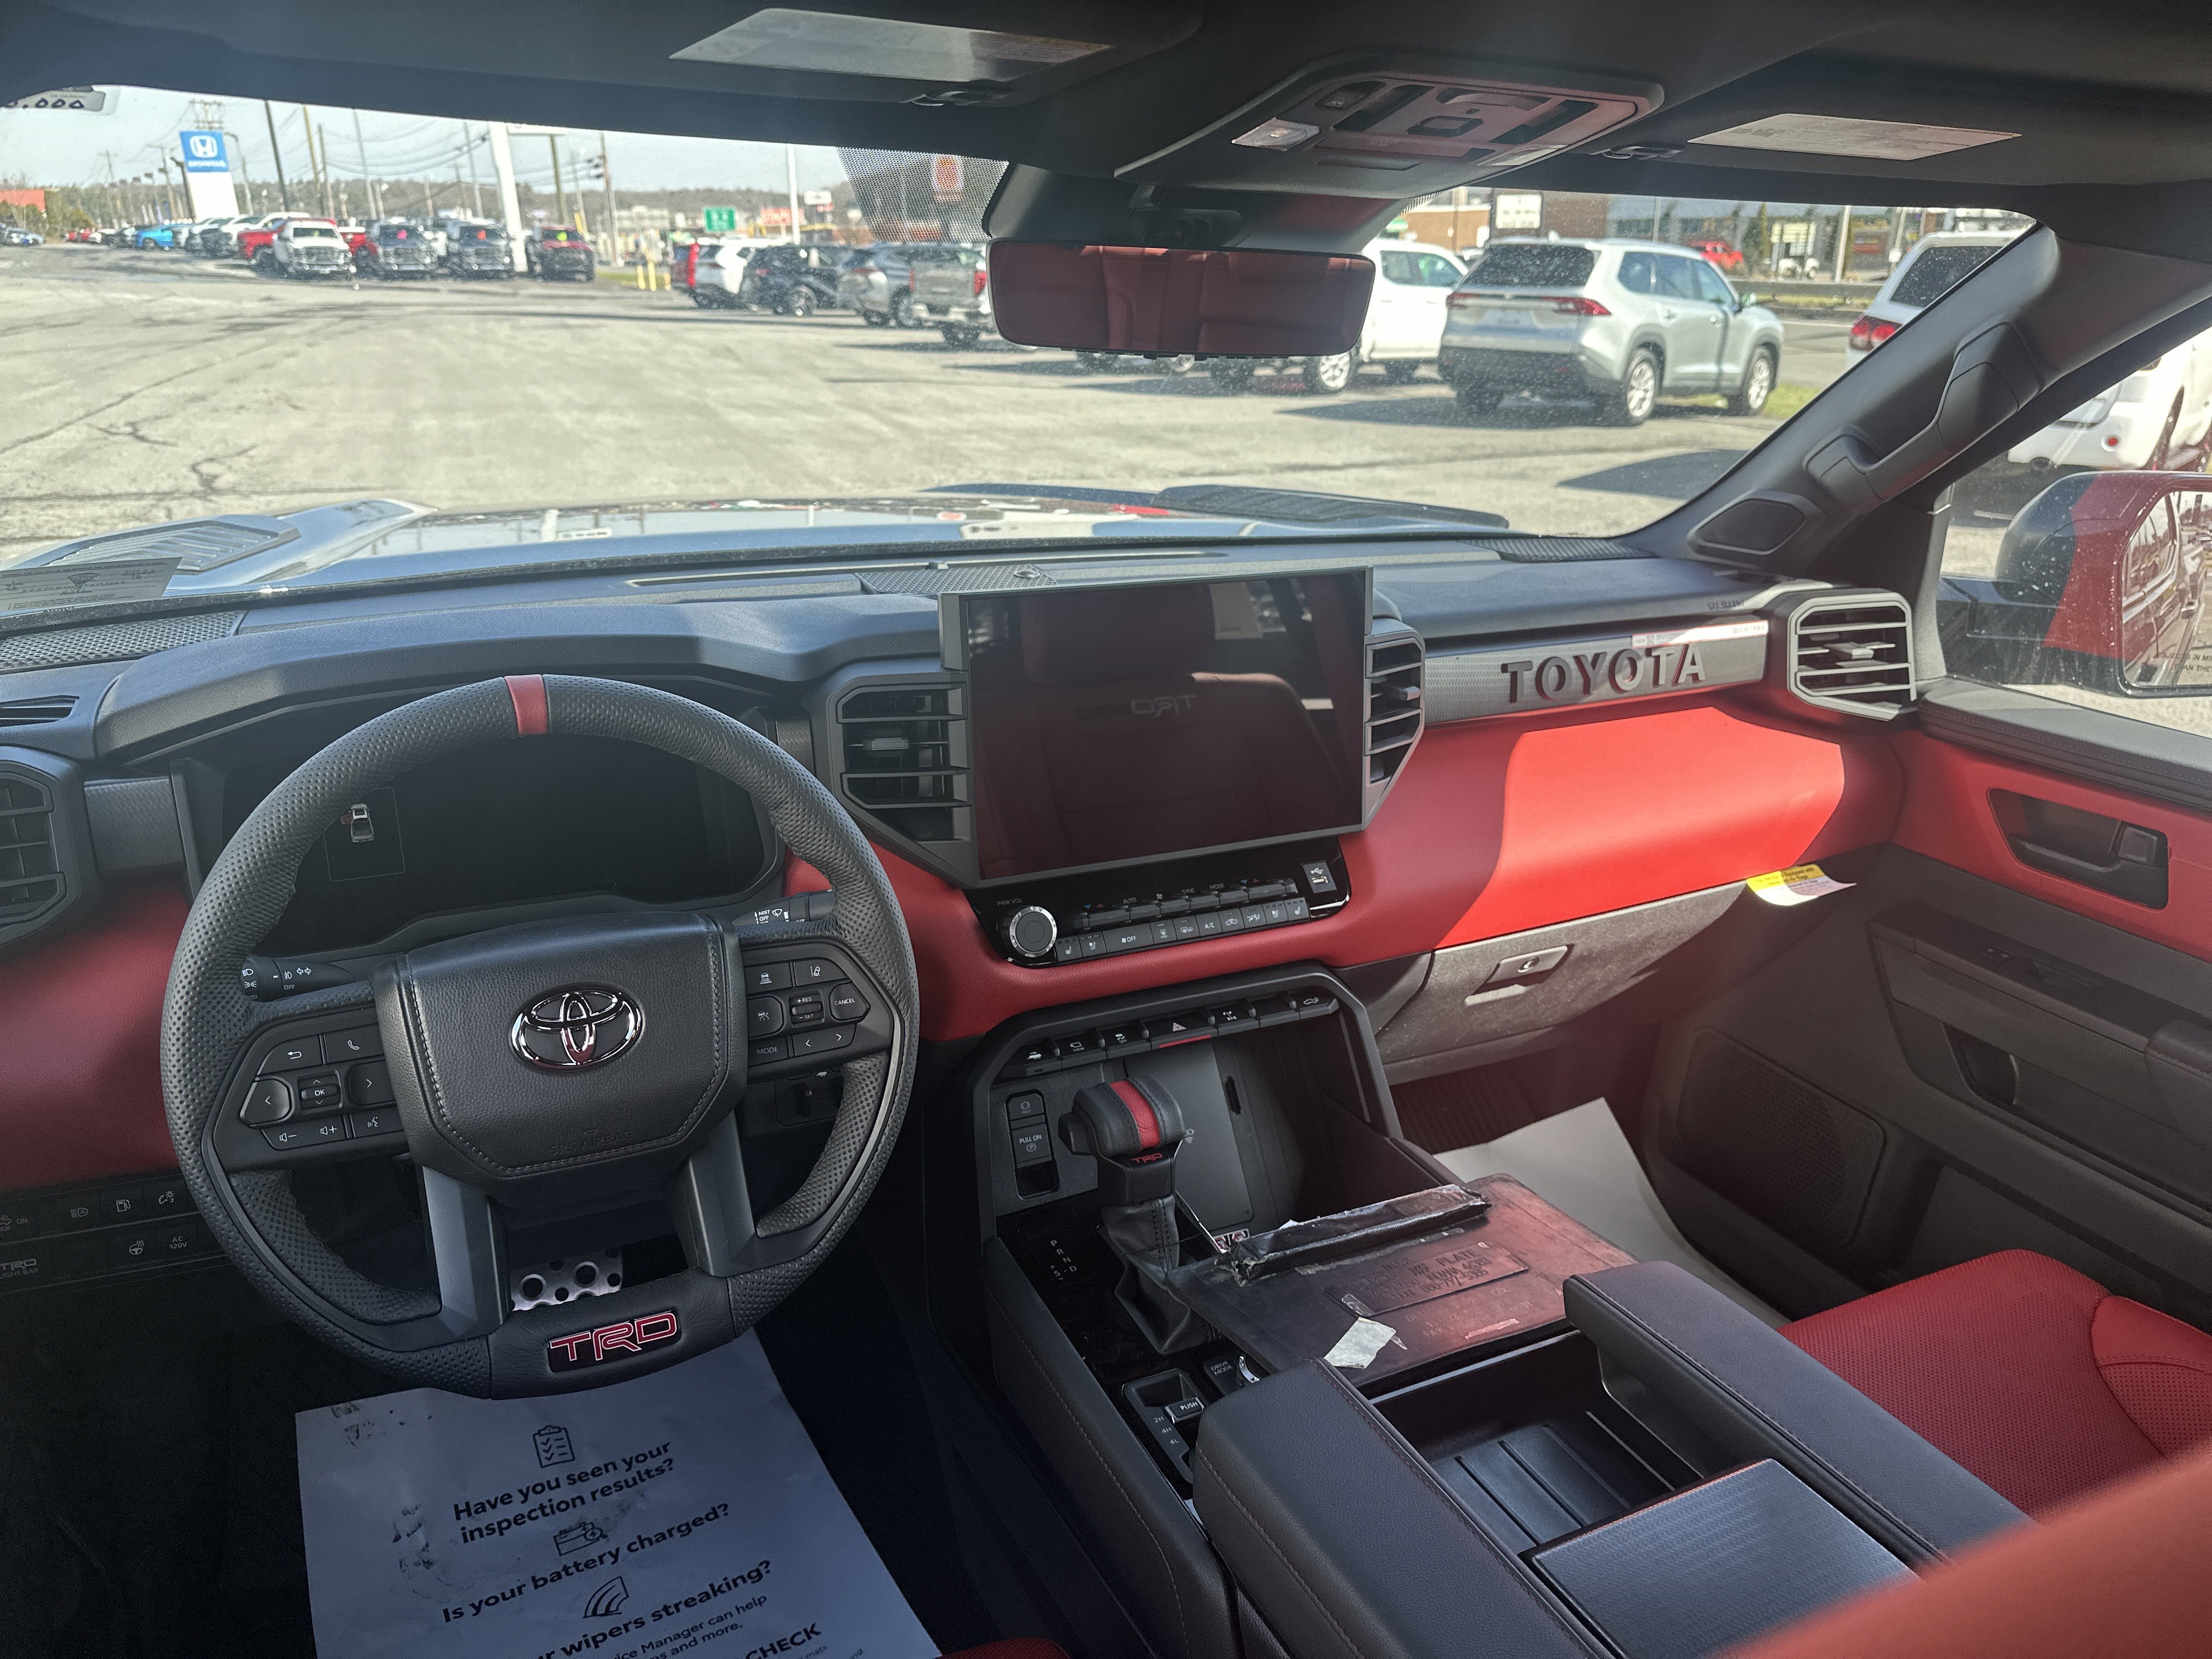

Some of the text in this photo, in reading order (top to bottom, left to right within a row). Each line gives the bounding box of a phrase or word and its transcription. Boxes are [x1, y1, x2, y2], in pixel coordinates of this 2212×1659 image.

[1502, 644, 1706, 703] TOYOTA
[757, 1046, 778, 1054] MODE
[1019, 1136, 1032, 1144] PULL
[1131, 1153, 1163, 1164] TRD
[1436, 1249, 1481, 1266] PLATE
[550, 1311, 678, 1362] TRD
[1210, 1361, 1229, 1372] DRIVE
[1214, 1364, 1233, 1375] MODE
[1180, 1401, 1199, 1410] PUSH
[454, 1442, 670, 1521] Have you seen your
[460, 1458, 674, 1543] inspection results?
[443, 1503, 730, 1623] Is your battery charged?
[560, 1616, 646, 1656] wipers
[651, 1560, 771, 1621] streaking?
[641, 1595, 767, 1654] Manager can help
[671, 1622, 743, 1656] and more.
[746, 1622, 822, 1659] CHECK
